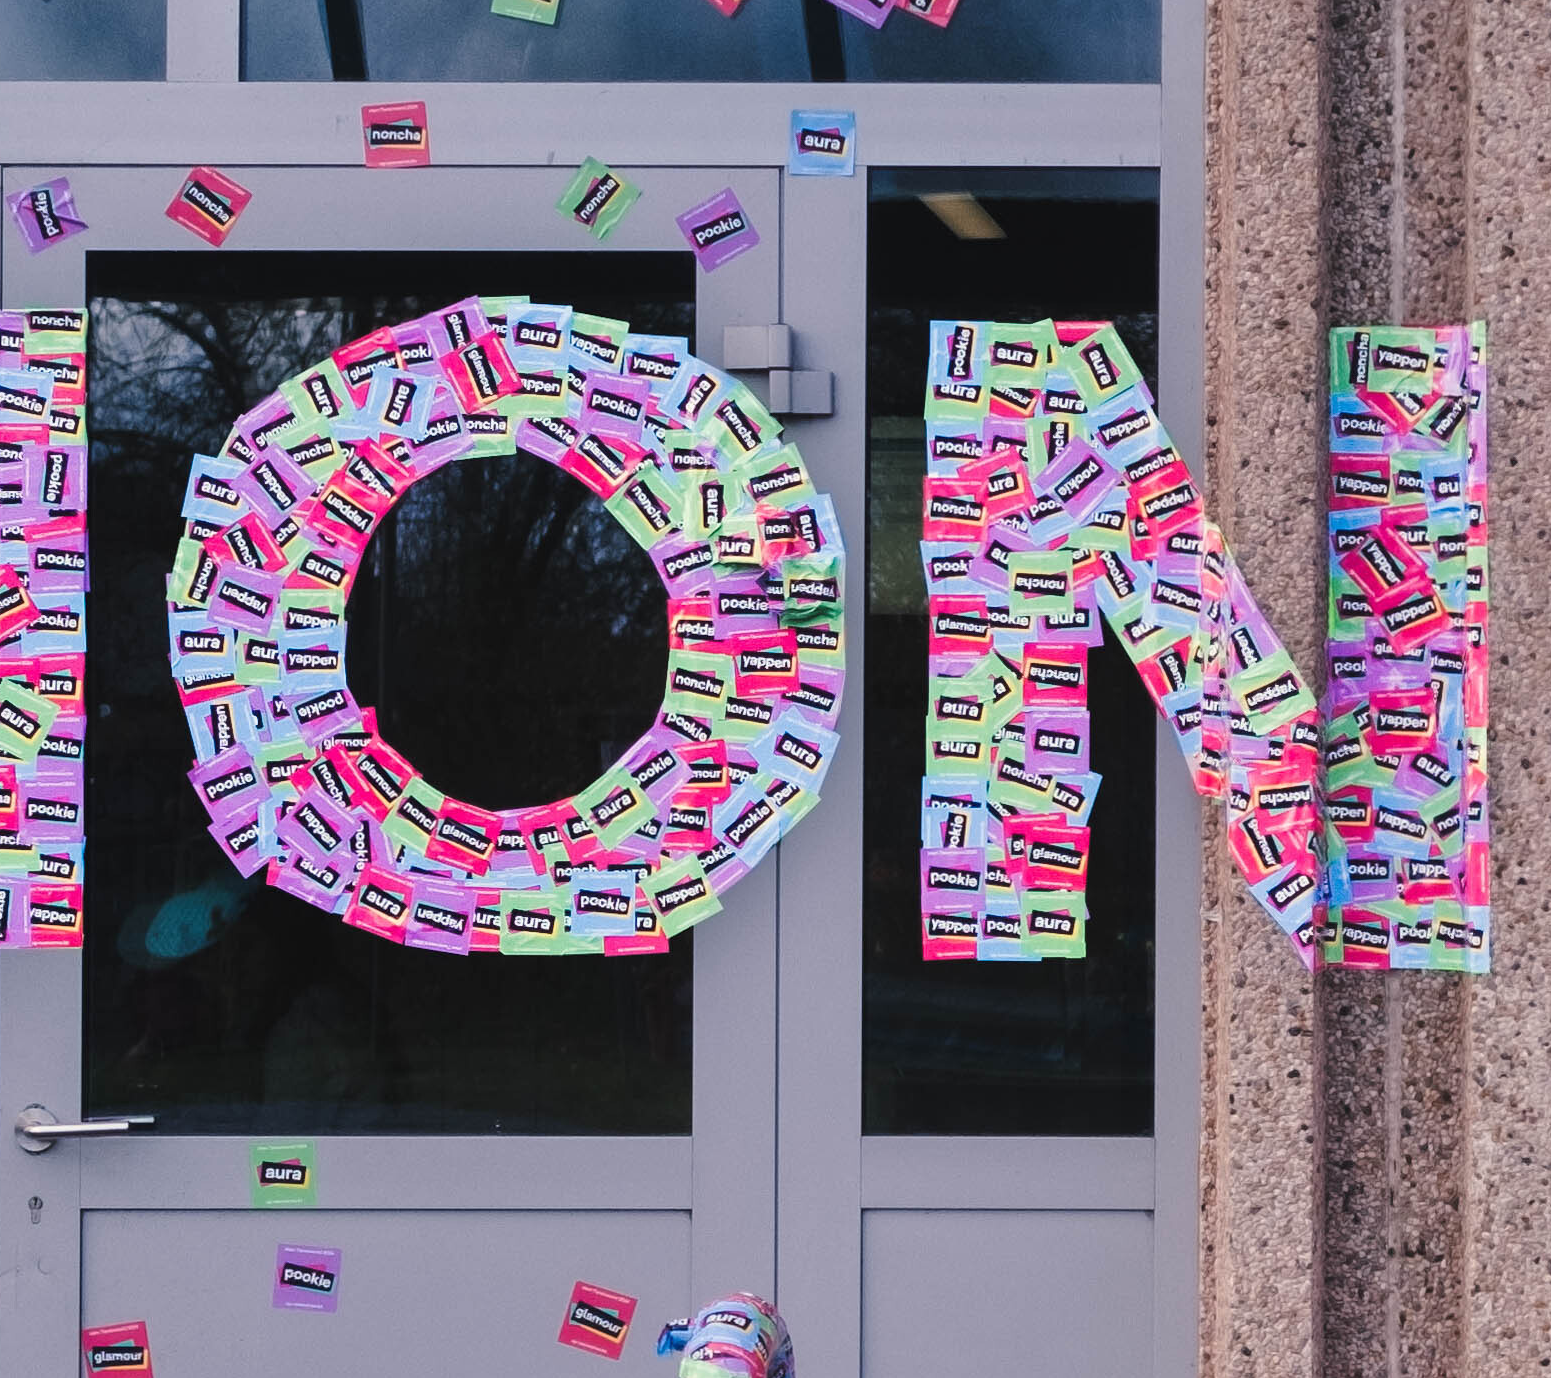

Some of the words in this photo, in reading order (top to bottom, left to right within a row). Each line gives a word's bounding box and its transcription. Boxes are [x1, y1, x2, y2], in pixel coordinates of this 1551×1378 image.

[372, 128, 420, 141] noncha
[804, 135, 842, 155] aura
[189, 187, 229, 222] noncha
[580, 179, 616, 219] noncha
[35, 192, 59, 236] pookie
[696, 218, 742, 244] pookie
[33, 315, 81, 329] noncha
[954, 329, 971, 376] pookie
[997, 348, 1033, 363] aura
[1379, 350, 1426, 369] yappen
[468, 350, 493, 395] glamour
[1089, 350, 1111, 385] aura
[592, 394, 638, 417] pookie
[1340, 477, 1387, 494] yappen
[326, 494, 368, 530] yappen
[632, 485, 665, 528] noncha
[306, 559, 341, 582] aura
[1016, 577, 1065, 590] noncha
[222, 585, 267, 614] yappen
[1387, 601, 1435, 626] yappen
[184, 633, 224, 649] aura
[743, 655, 791, 669] yappen
[1031, 667, 1078, 681] noncha
[942, 702, 979, 717] aura
[1, 708, 34, 735] aura
[1380, 714, 1427, 729] yappen
[1039, 735, 1075, 750] aura
[28, 804, 75, 819] pookie
[299, 807, 336, 848] yappen
[442, 824, 488, 850] glamour
[1032, 847, 1081, 865] glamour
[930, 872, 978, 887] pookie
[366, 891, 401, 915] aura
[580, 896, 627, 912] pookie
[658, 884, 704, 907] yappen
[514, 916, 551, 930] aura
[1035, 917, 1071, 931] aura
[265, 1168, 302, 1181] aura
[284, 1269, 331, 1288] pookie
[575, 1308, 621, 1333] glamour
[94, 1351, 143, 1364] glamour
